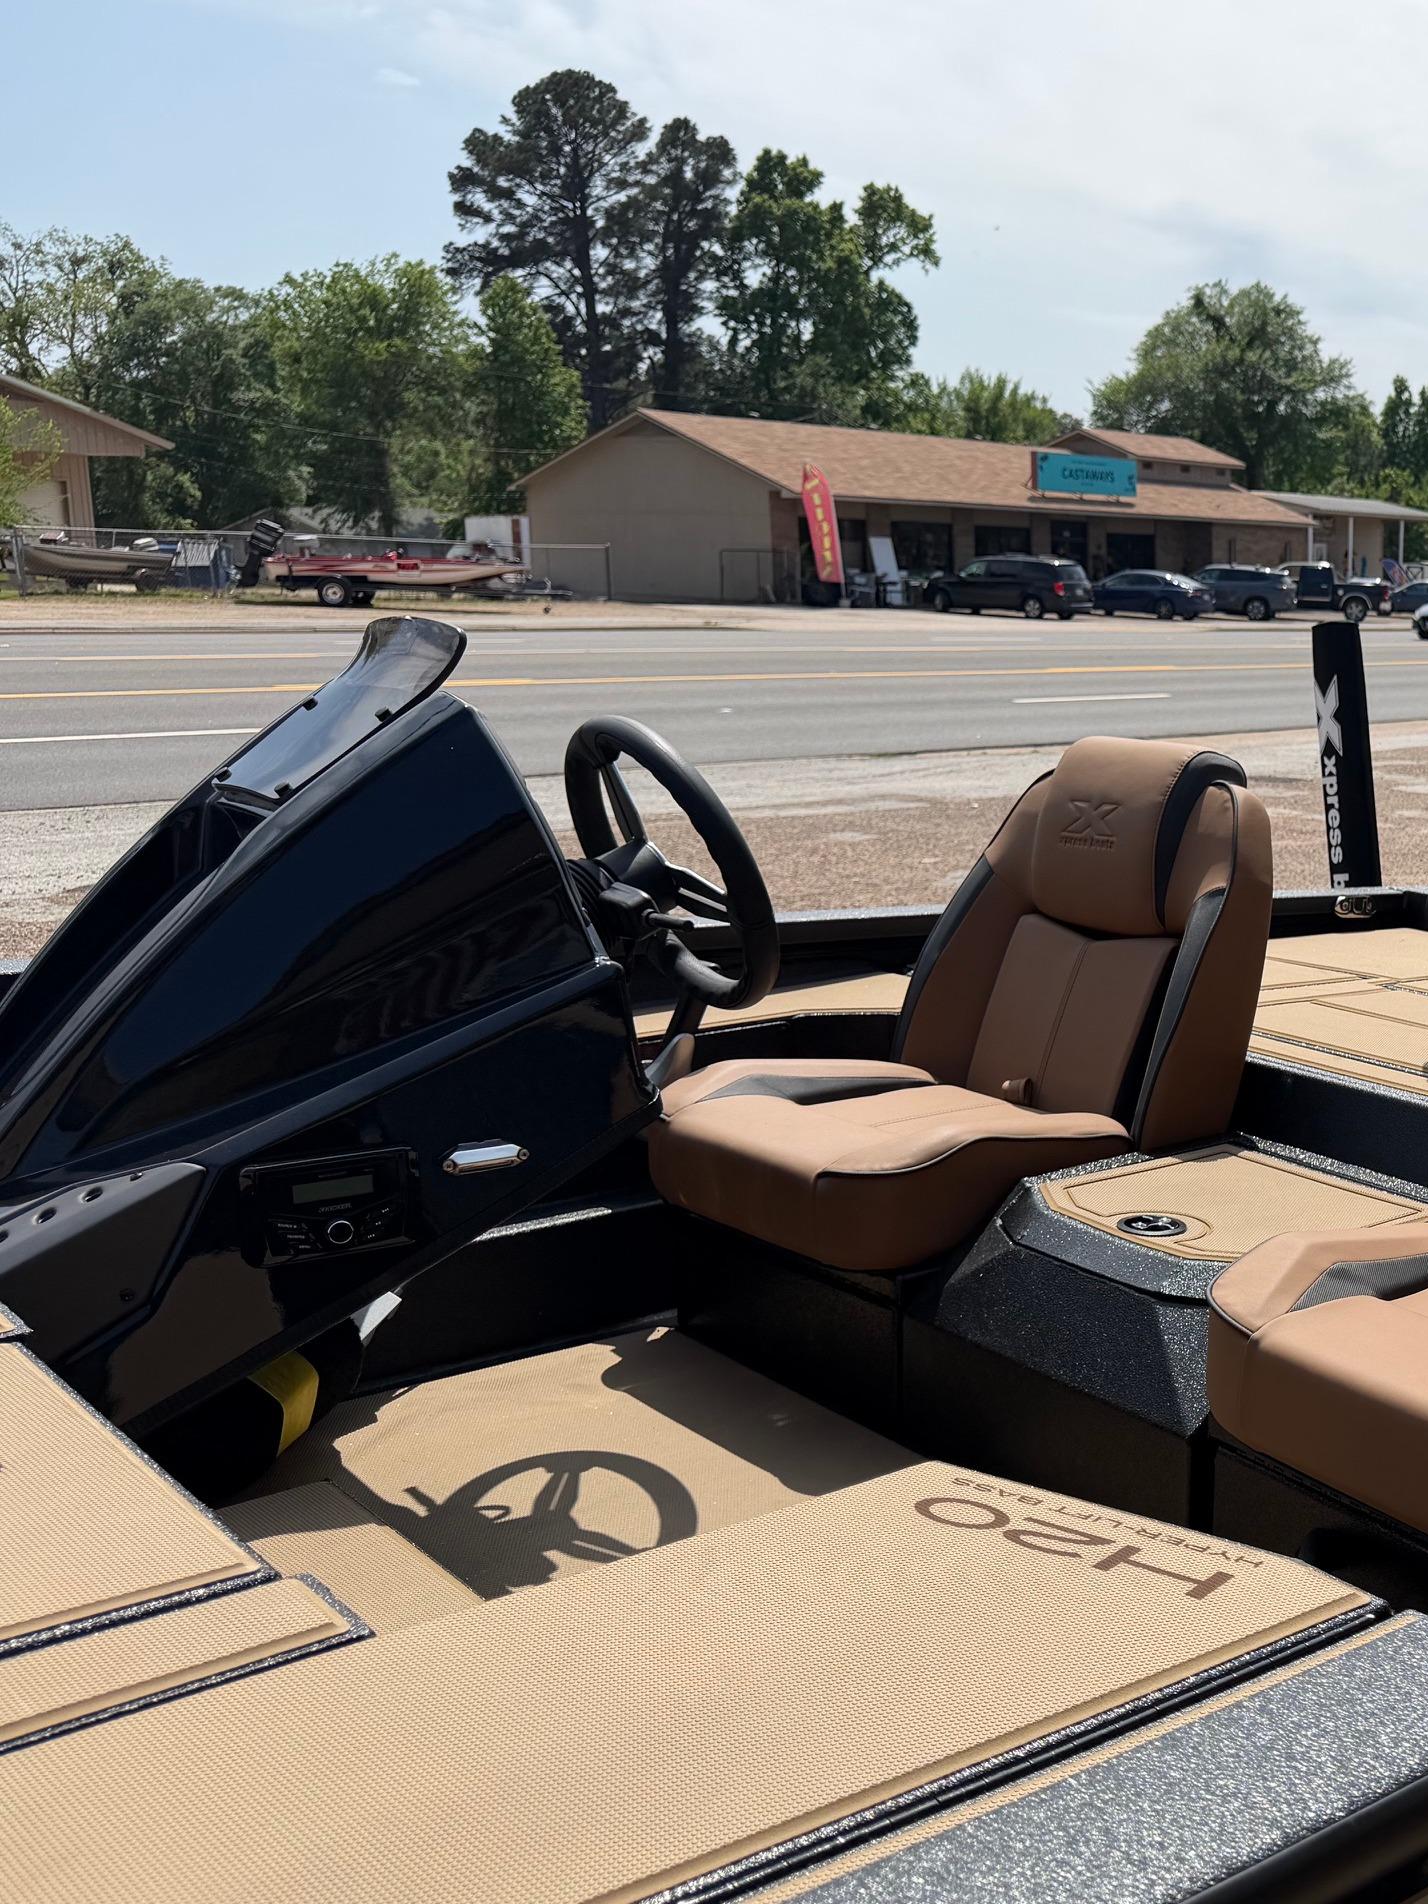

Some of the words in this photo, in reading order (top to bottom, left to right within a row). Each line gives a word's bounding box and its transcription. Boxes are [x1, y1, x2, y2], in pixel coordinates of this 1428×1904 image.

[1322, 754, 1344, 865] xpress
[952, 1476, 1044, 1506] BASS
[914, 1497, 1235, 1601] H2O
[1049, 1505, 1264, 1568] HYPER-LIFT
